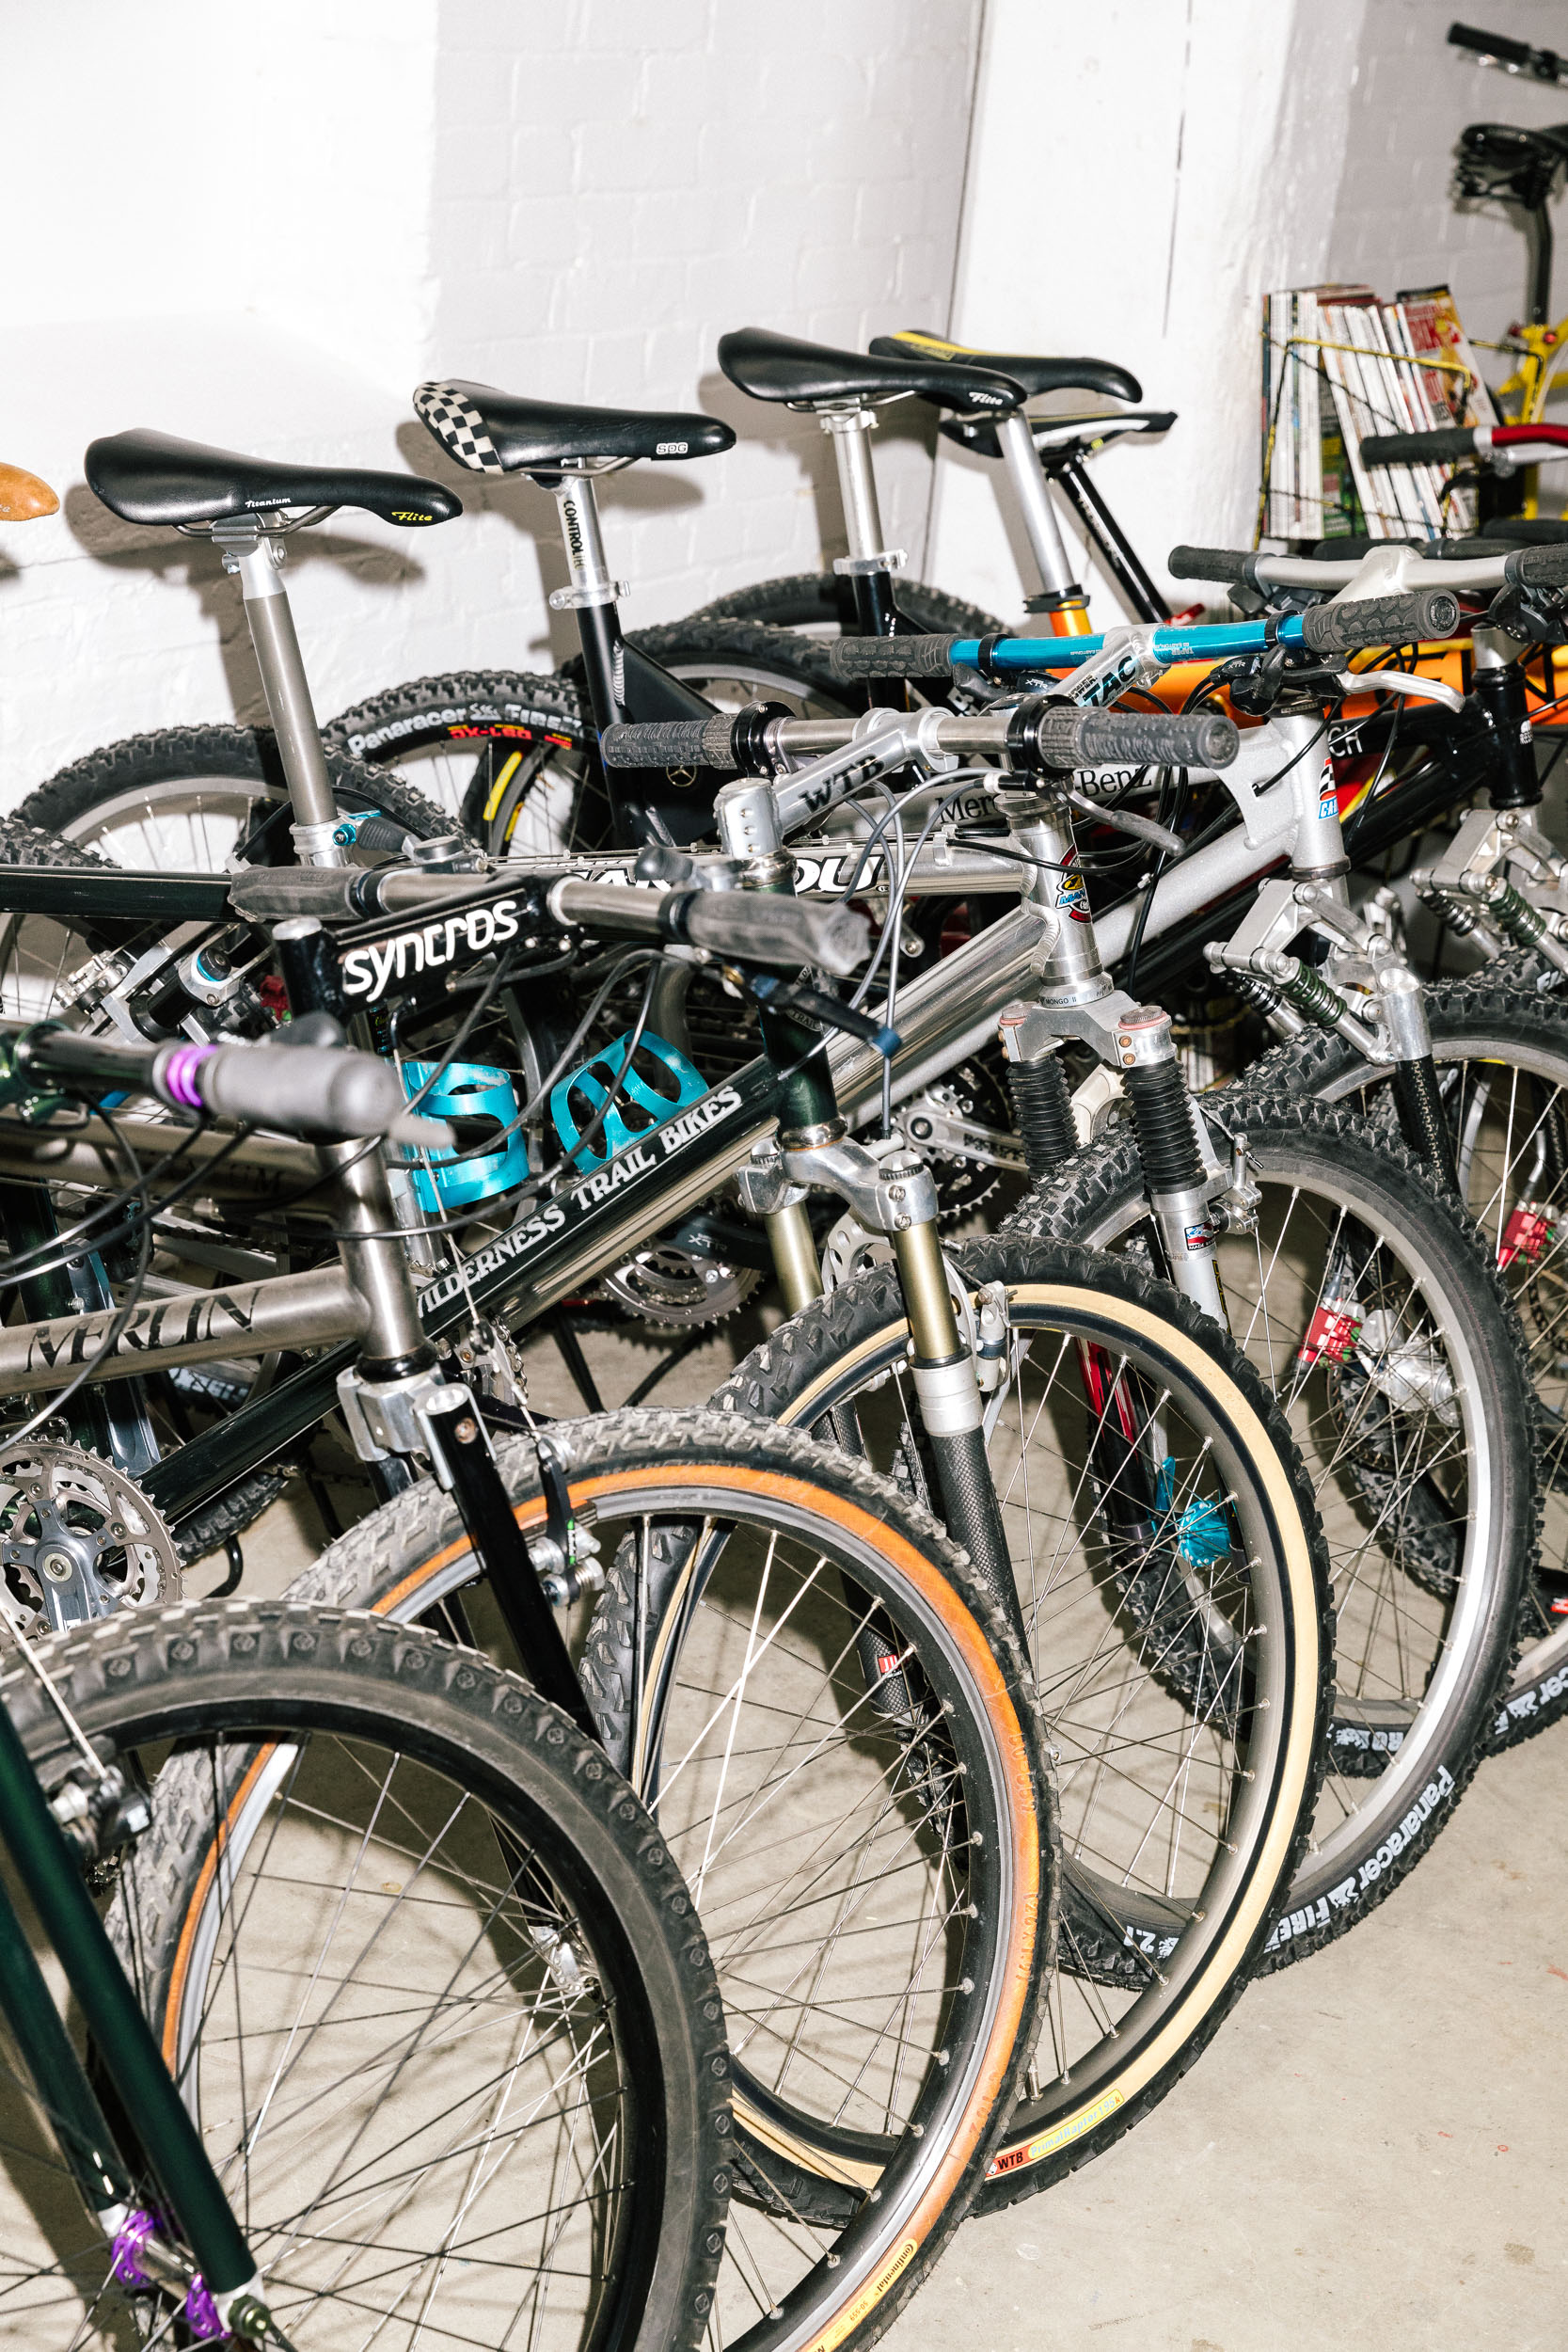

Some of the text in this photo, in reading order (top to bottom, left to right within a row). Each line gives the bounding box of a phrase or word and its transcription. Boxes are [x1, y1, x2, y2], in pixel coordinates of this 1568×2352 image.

[656, 441, 689, 454] SDG
[245, 497, 292, 508] Titanium
[391, 511, 433, 522] Flite
[347, 707, 468, 756] Panaracer
[798, 754, 885, 813] WTB
[570, 1145, 658, 1212] TRAIL
[658, 1085, 744, 1155] BIKES
[23, 1285, 265, 1374] MERLIN
[1351, 1764, 1456, 1891] Panaracer
[1122, 1925, 1157, 1954] 2.1
[997, 2151, 1024, 2170] WTB
[878, 2243, 915, 2293] Continental
